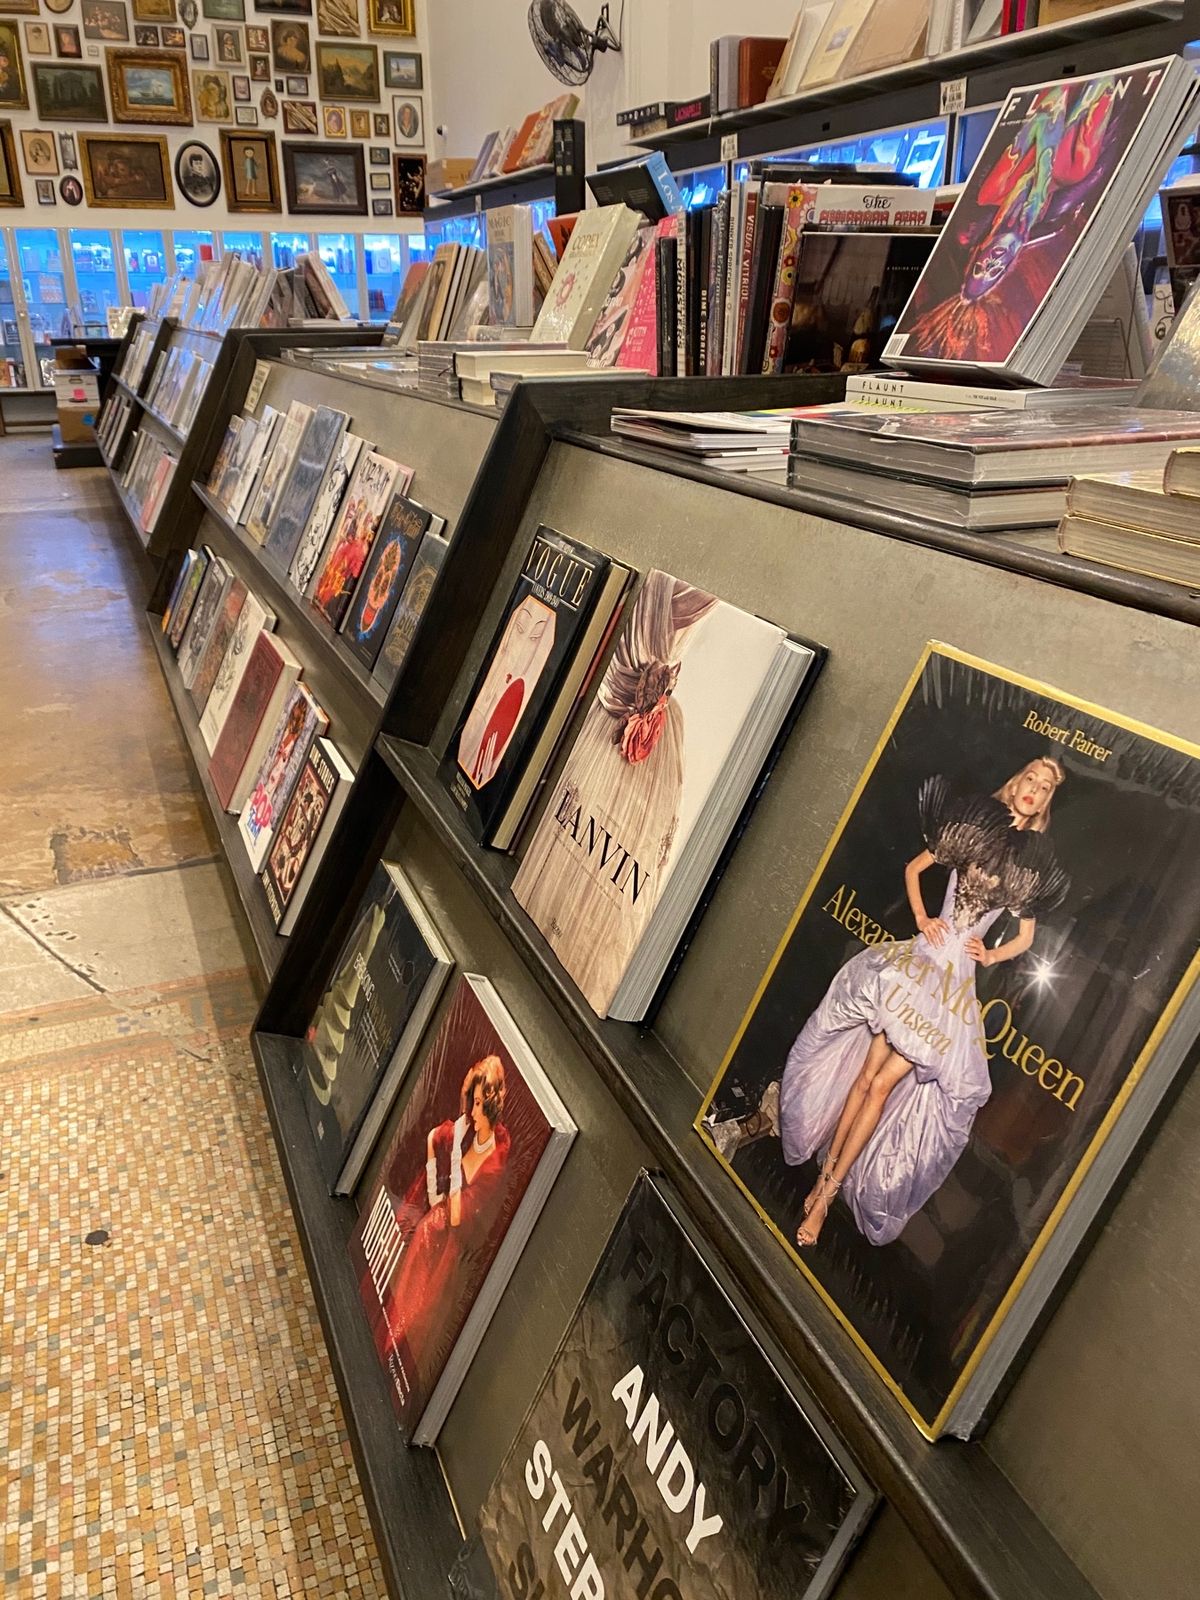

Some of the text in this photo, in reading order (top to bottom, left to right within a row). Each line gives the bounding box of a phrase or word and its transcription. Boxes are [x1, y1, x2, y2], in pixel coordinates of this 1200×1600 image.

[1003, 69, 1163, 120] FLAUNT
[863, 194, 896, 209] The
[744, 215, 755, 255] VISUAL
[739, 259, 750, 305] VITRIOL
[861, 395, 903, 407] FLAUNT
[862, 381, 905, 393] FLAUNT
[525, 540, 593, 606] VOGUE
[1022, 710, 1113, 764] Robert Fairer
[555, 790, 651, 906] LANVIN
[822, 884, 1088, 1112] Alexander McQueen
[885, 983, 953, 1057] Unseen
[360, 1185, 406, 1305] NORELL
[611, 1364, 724, 1554] ANDY
